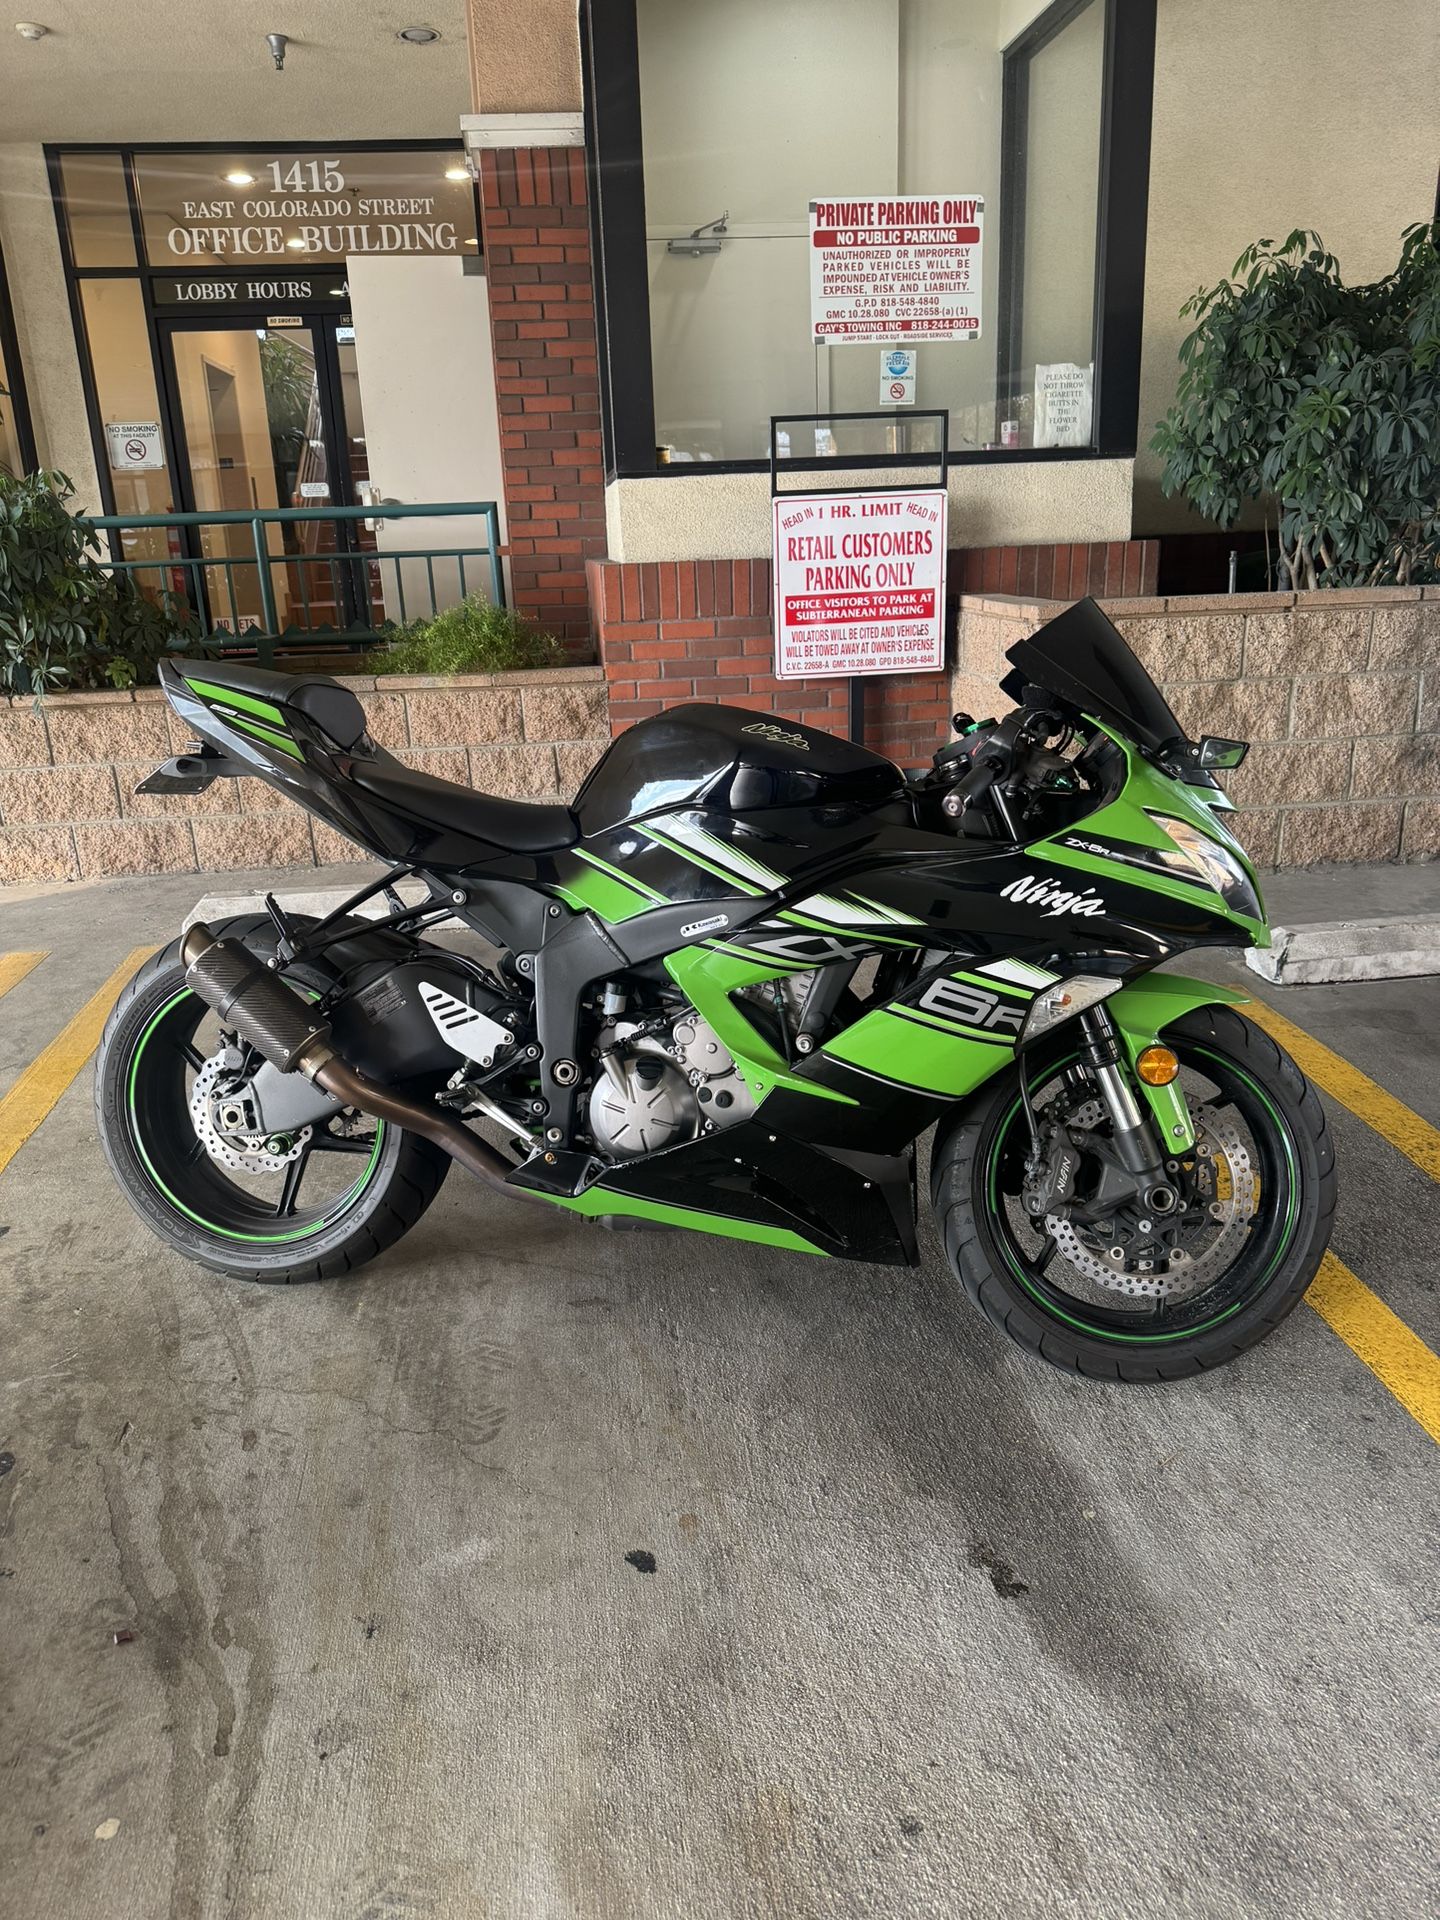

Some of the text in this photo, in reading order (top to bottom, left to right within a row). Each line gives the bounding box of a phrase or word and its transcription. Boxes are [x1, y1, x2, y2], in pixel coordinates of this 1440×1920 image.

[266, 159, 345, 193] 1415
[183, 197, 435, 219] EAST COLORADO STREET
[816, 200, 977, 227] PRIVATE PARKING ONLY
[168, 222, 458, 256] OFFICE BUILDING
[836, 229, 957, 245] NO PUBLIC PARKING
[823, 247, 971, 261] UNAUTHORIZED OR IMPROPERLY
[823, 259, 970, 272] PARKED VEHICLES WILL BE
[823, 270, 970, 284] IMPOUNDED AT VEHICLE OWNER'S
[175, 282, 238, 301] LOBBY
[247, 281, 313, 299] HOURS
[823, 282, 969, 295] EXPENSE, RISK AND LIABILITY.
[880, 296, 940, 307] 818-548-4840
[826, 309, 846, 319] GMC
[848, 308, 890, 318] 10.28.080
[895, 307, 912, 317] CVC
[818, 319, 977, 333] GAY'S TOWING INC 818-244-0015
[875, 333, 889, 341] LOCK
[1046, 372, 1083, 381] PLEASE DO
[1049, 416, 1077, 424] FLOWER
[121, 425, 157, 433] SMOKING
[782, 506, 814, 530] HEAD IN
[818, 502, 903, 519] 1 HR. LIMIT
[906, 502, 939, 523] HEAD IN
[788, 530, 933, 561] RETAIL CUSTOMERS
[806, 562, 915, 591] PARKING ONLY
[787, 592, 934, 609] OFFICE VISITORS TO PARK AT
[796, 605, 924, 621] SUBTERRANEAN PARKING
[791, 624, 929, 643] VIOLATORS WILL BE CITED AND VEHICLES
[786, 638, 934, 658] WILL BE TOWED AWAY AT OWNER'S EXPENSE
[832, 659, 846, 669] GMC
[879, 657, 892, 666] GPD
[741, 722, 810, 751] Ninja
[1065, 837, 1110, 856] ZX-6R
[1000, 875, 1107, 918] Ninja
[1056, 1155, 1071, 1194] NISSIN
